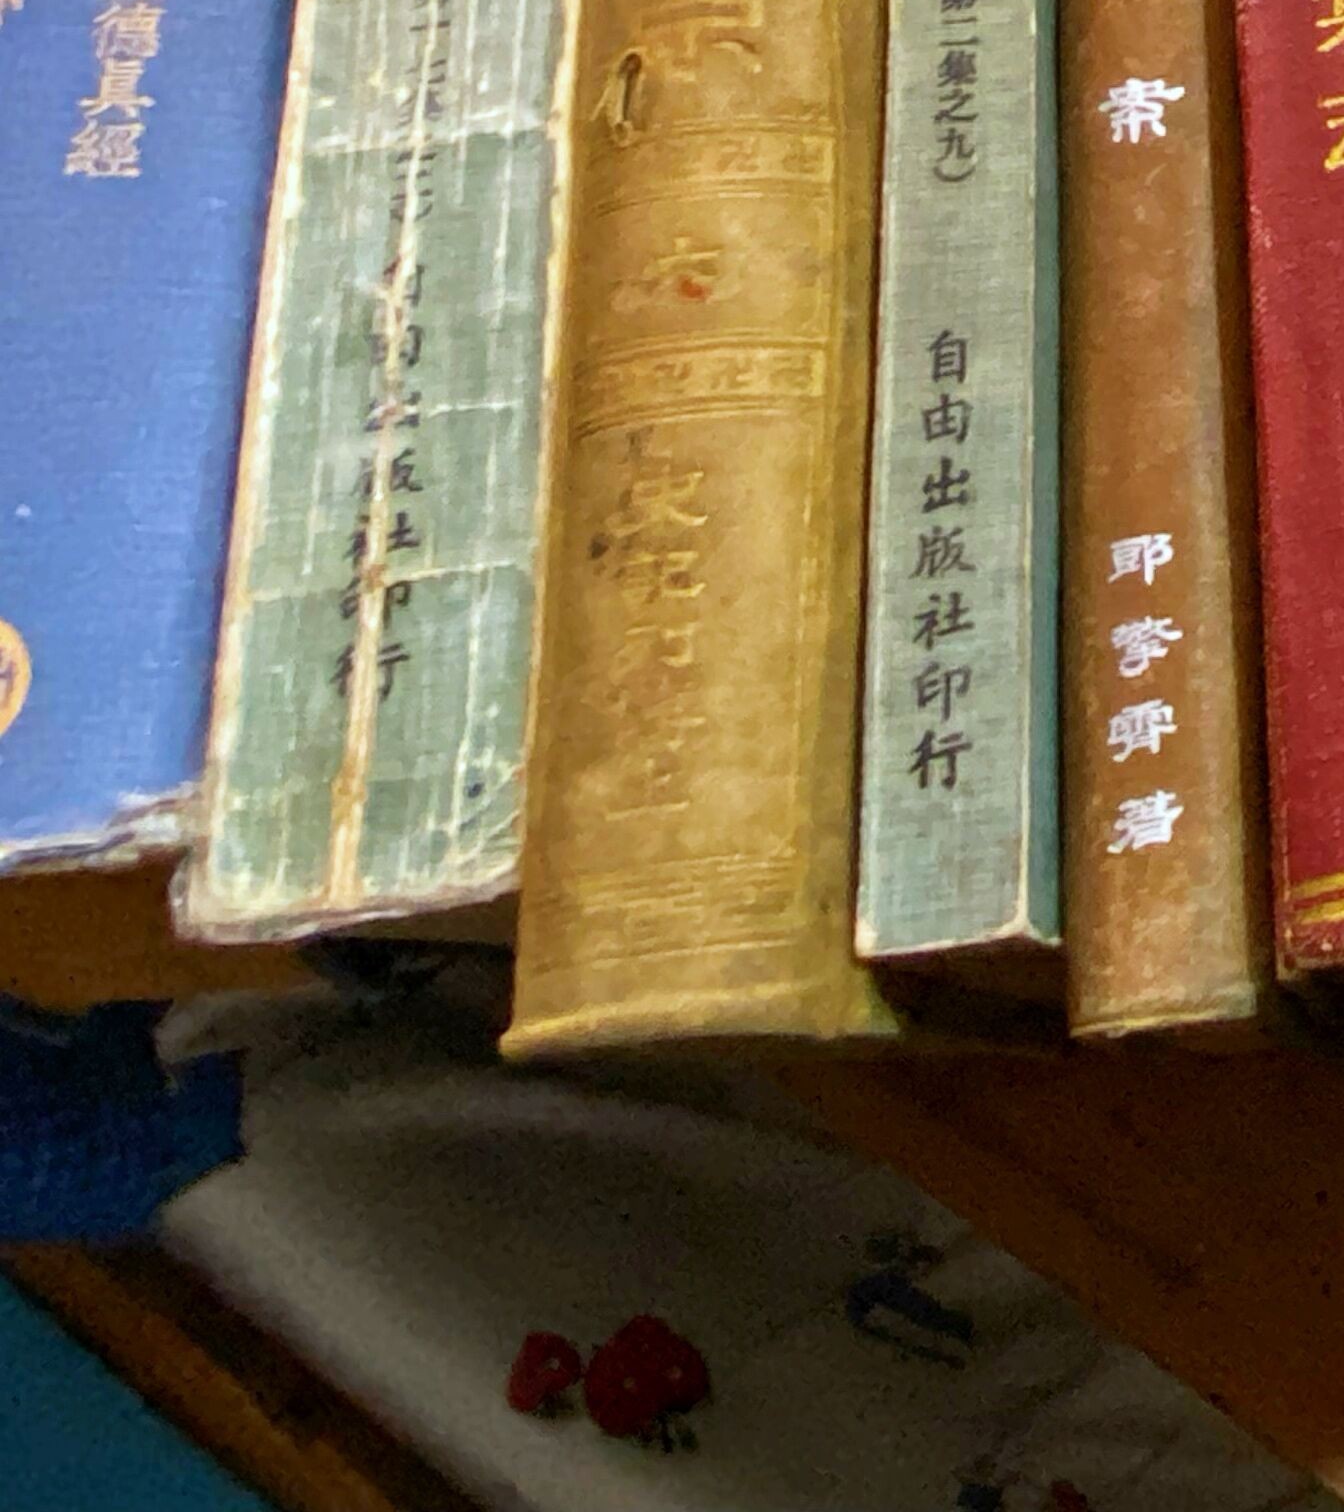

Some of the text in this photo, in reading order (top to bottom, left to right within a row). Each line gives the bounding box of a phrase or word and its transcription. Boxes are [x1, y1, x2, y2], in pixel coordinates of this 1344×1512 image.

[908, 328, 978, 792] 自由出版社印行
